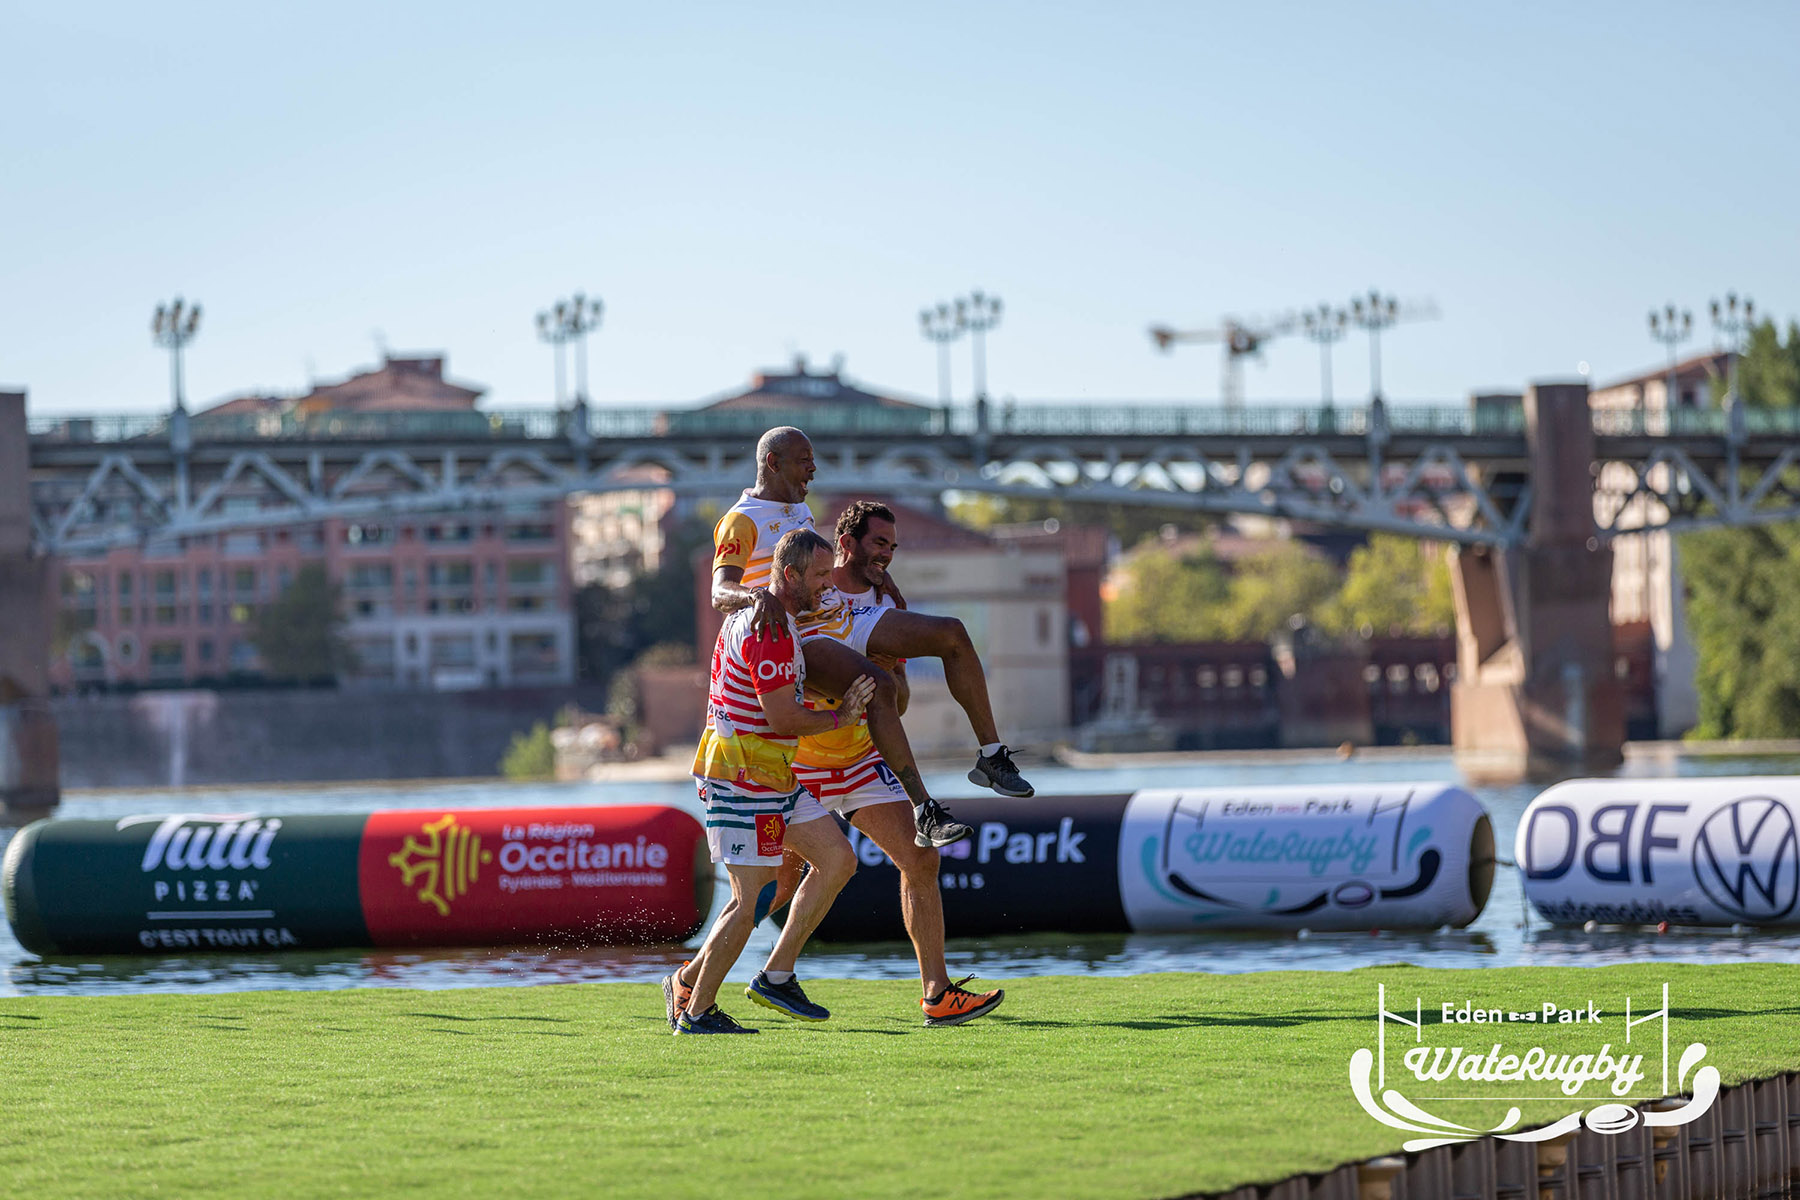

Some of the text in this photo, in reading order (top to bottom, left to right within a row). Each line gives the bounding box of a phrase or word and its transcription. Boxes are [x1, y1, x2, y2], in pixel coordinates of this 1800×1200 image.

[1222, 798, 1353, 816] Eden Park
[115, 811, 284, 873] Tutti
[503, 824, 526, 840] La
[978, 817, 1086, 865] Park
[500, 835, 668, 873] Occitanie
[200, 928, 259, 946] TOUT
